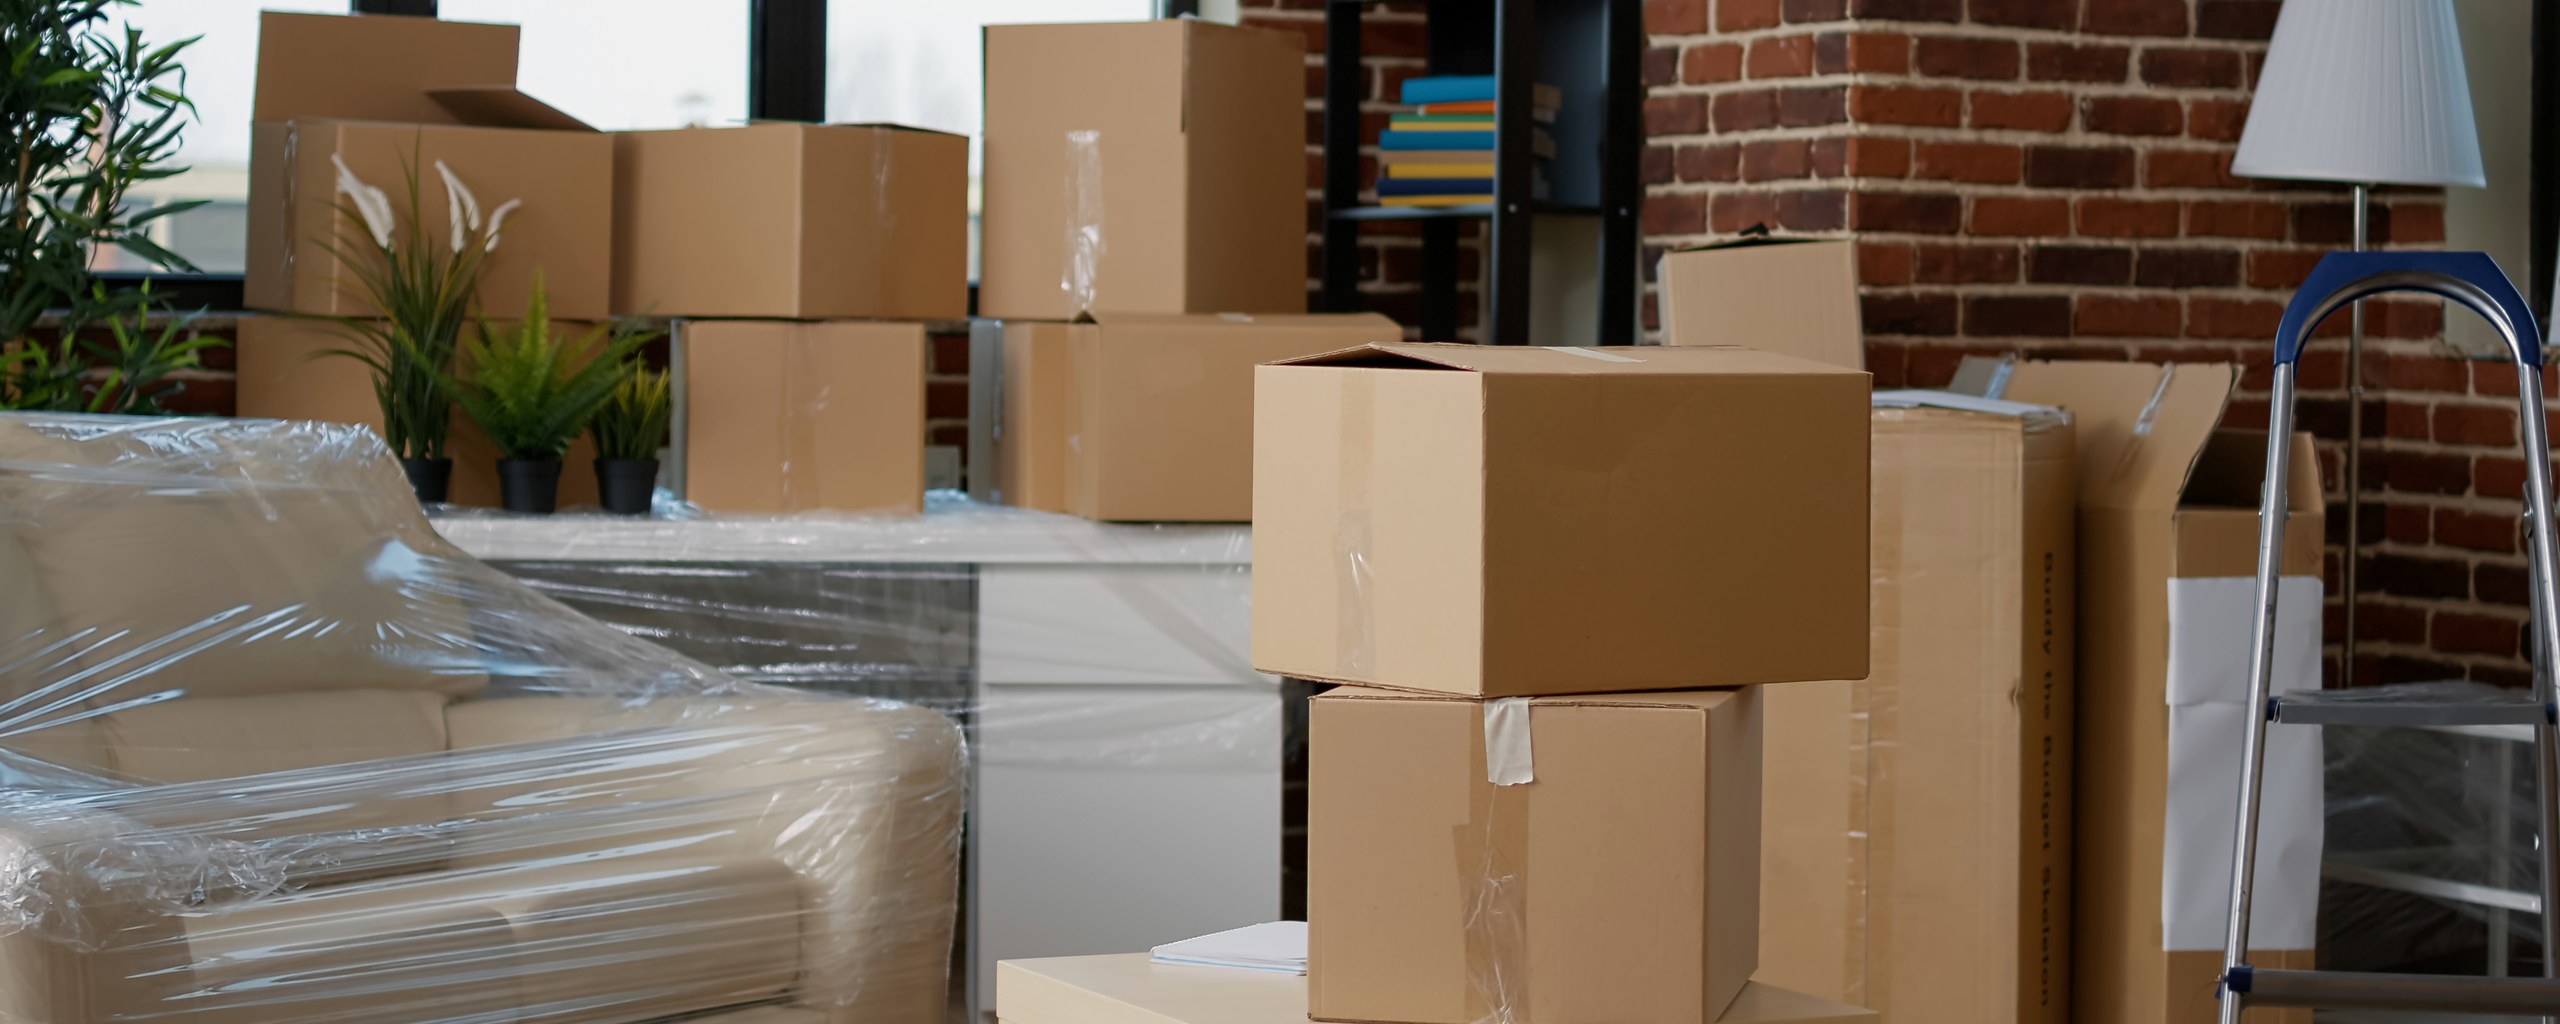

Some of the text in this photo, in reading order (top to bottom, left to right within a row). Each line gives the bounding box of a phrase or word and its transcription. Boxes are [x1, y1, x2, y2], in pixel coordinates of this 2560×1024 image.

[2041, 552, 2053, 1006] Buddy the Budget Skeleton
